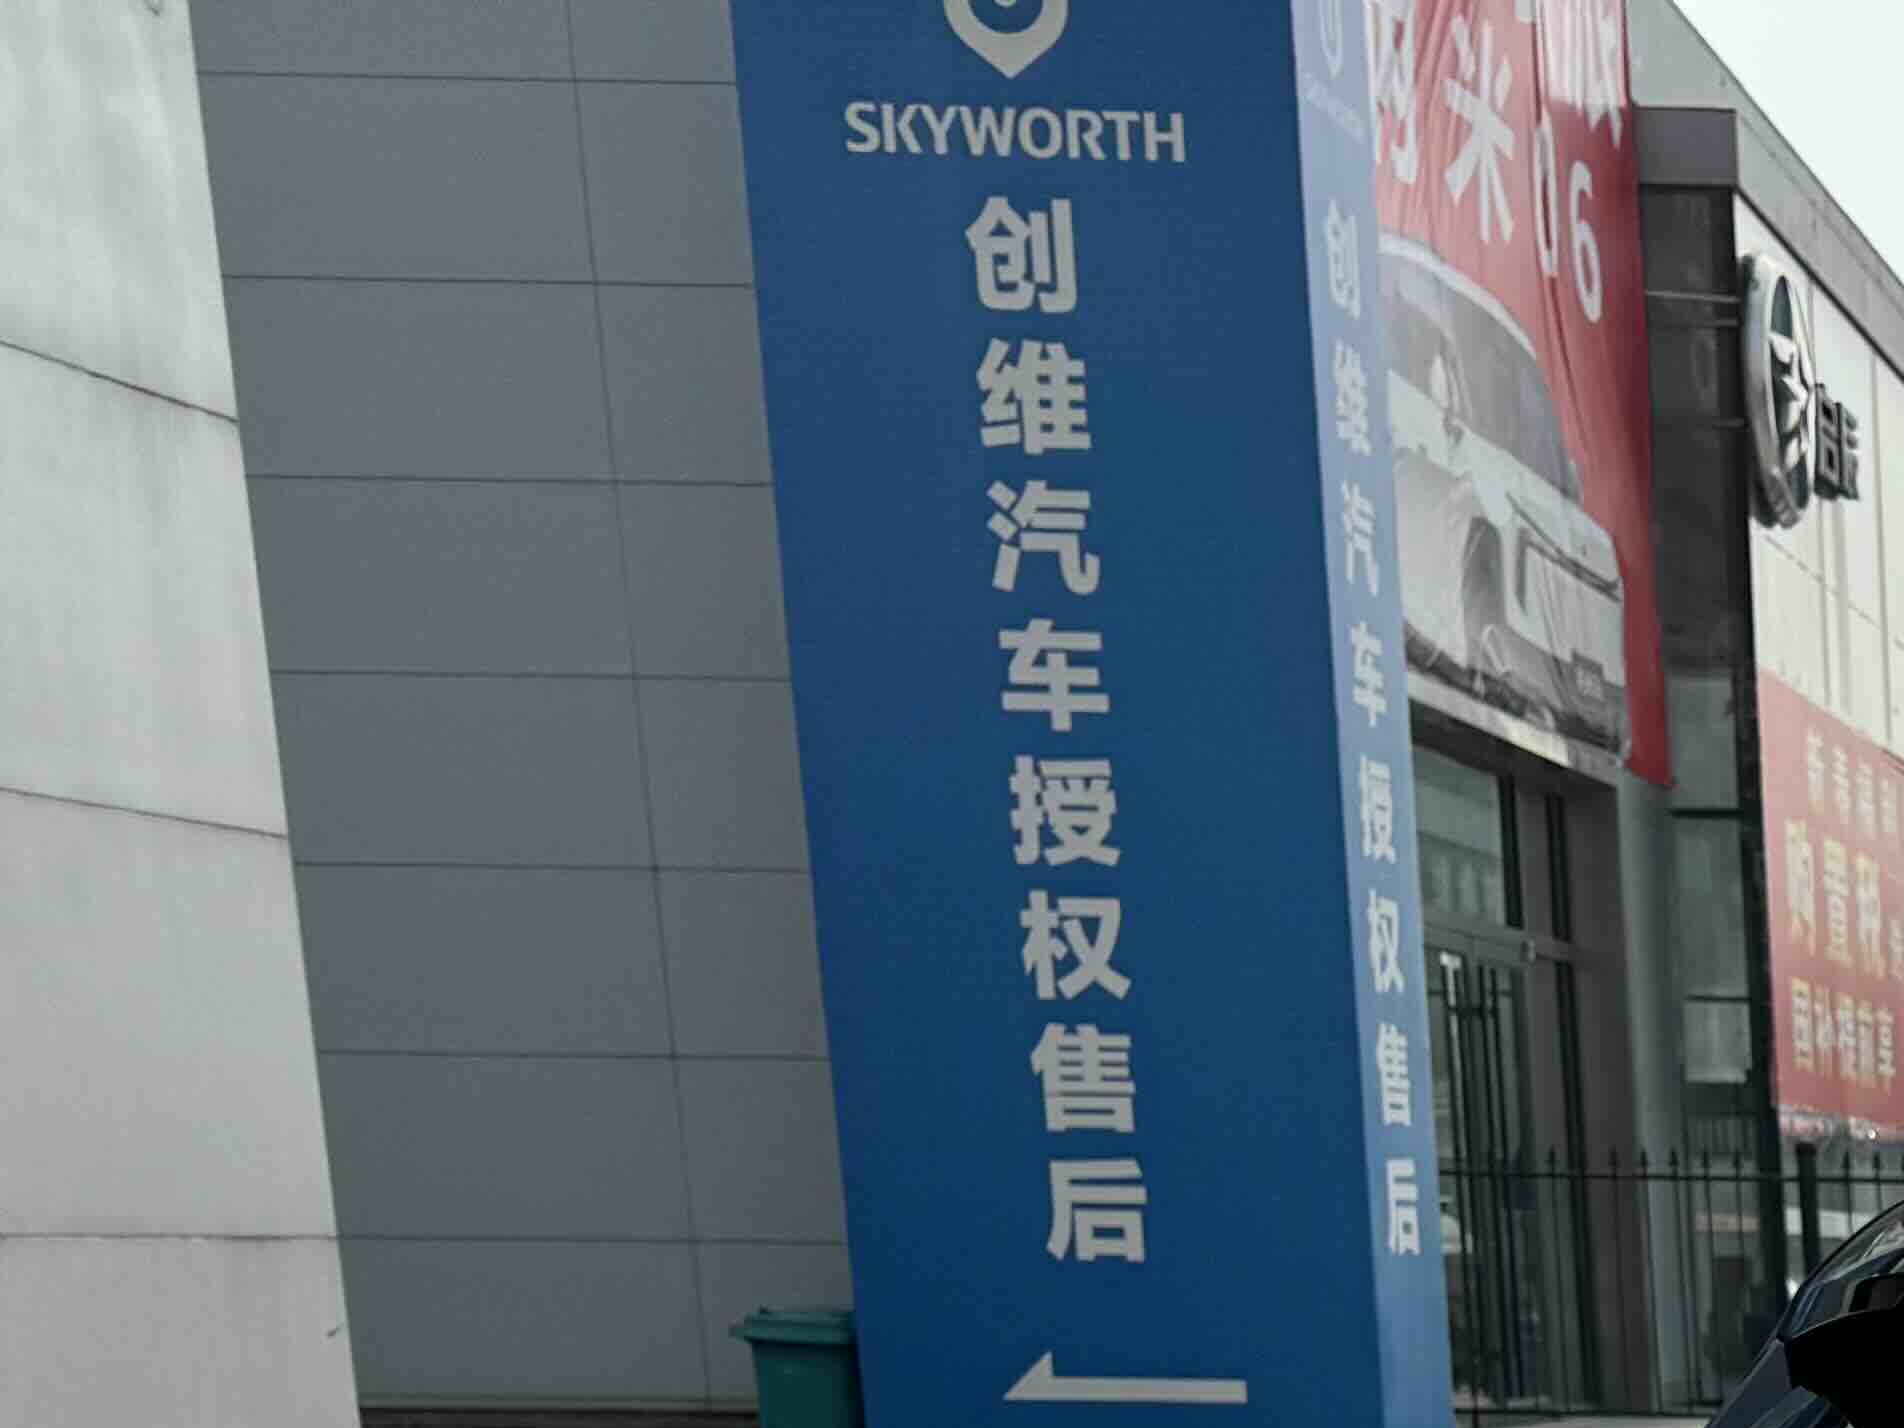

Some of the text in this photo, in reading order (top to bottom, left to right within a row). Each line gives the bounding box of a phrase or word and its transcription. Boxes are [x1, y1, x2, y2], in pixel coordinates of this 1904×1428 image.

[844, 101, 1186, 163] SKYWORTH
[965, 196, 1148, 1262] 创维汽车授权售后
